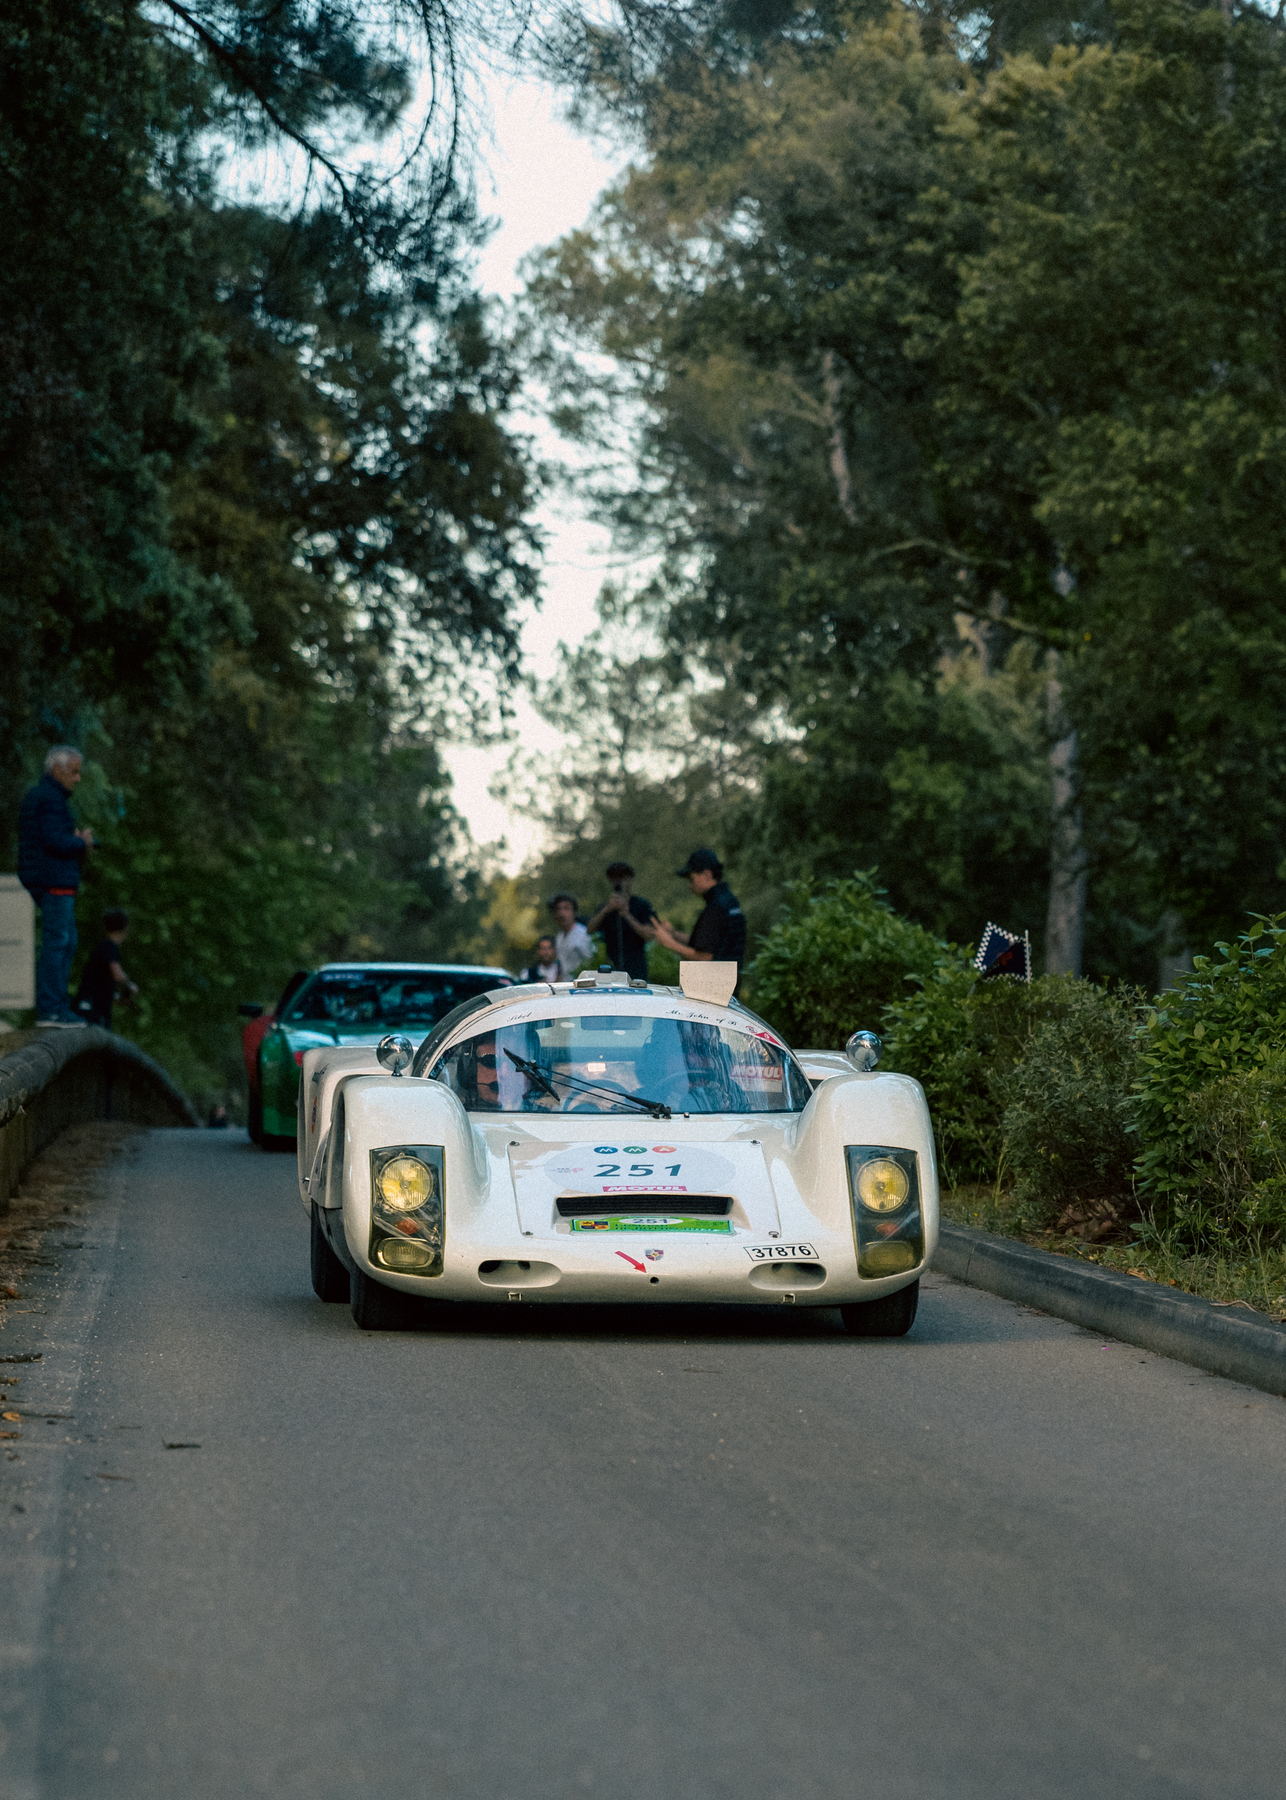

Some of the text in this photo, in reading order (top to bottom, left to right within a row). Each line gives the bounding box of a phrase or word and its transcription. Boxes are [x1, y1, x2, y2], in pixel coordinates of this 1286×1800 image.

[731, 1065, 782, 1079] MOTUL
[593, 1164, 682, 1177] 251
[631, 1217, 669, 1225] 251
[752, 1245, 812, 1259] 37876
